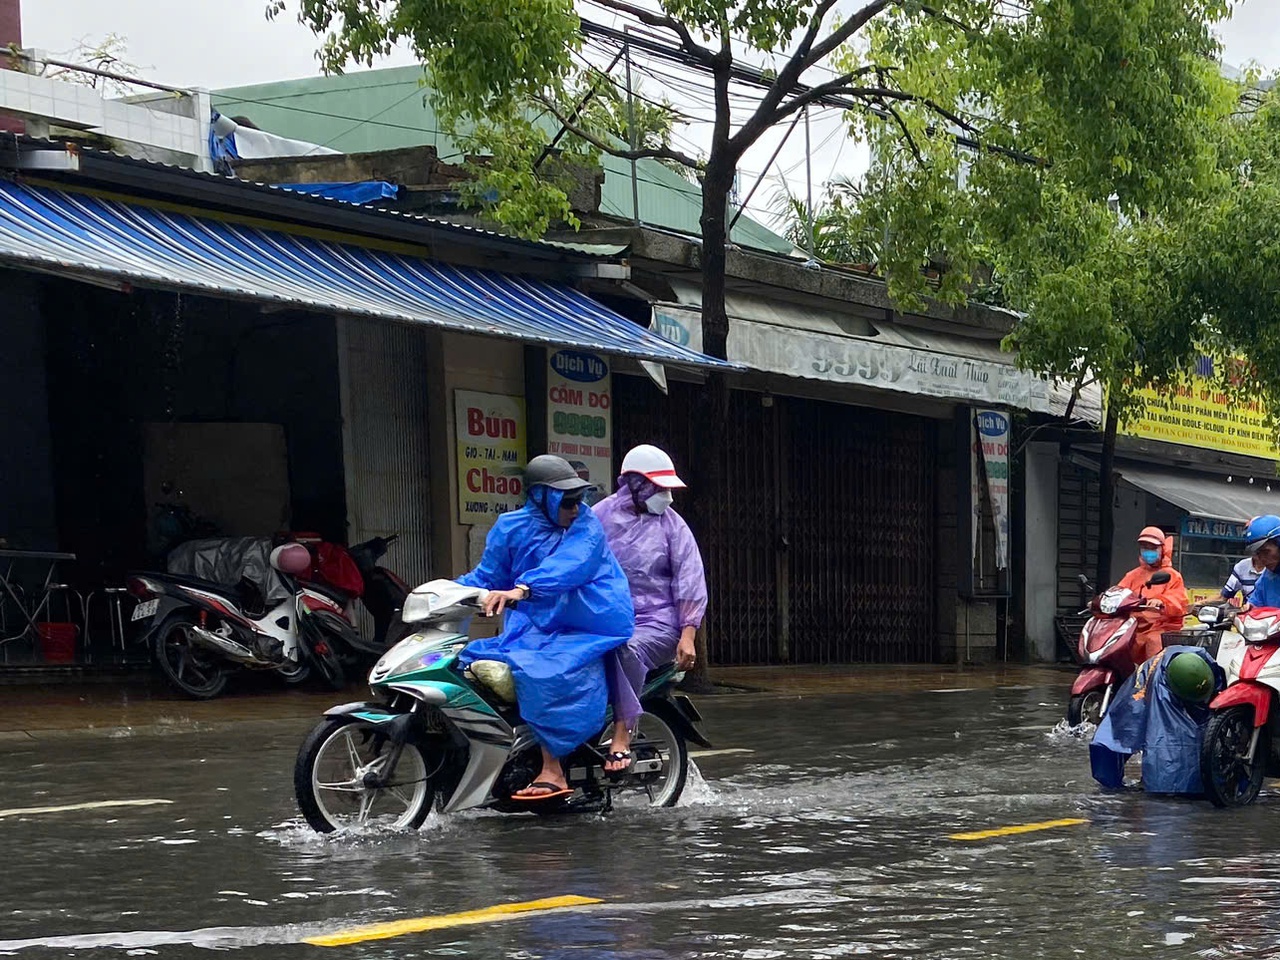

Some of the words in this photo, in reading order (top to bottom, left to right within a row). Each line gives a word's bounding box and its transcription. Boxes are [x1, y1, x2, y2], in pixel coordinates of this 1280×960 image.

[556, 353, 584, 374] Dịch
[587, 357, 603, 378] Vụ
[467, 407, 517, 440] Bún
[996, 417, 1006, 432] Vụ
